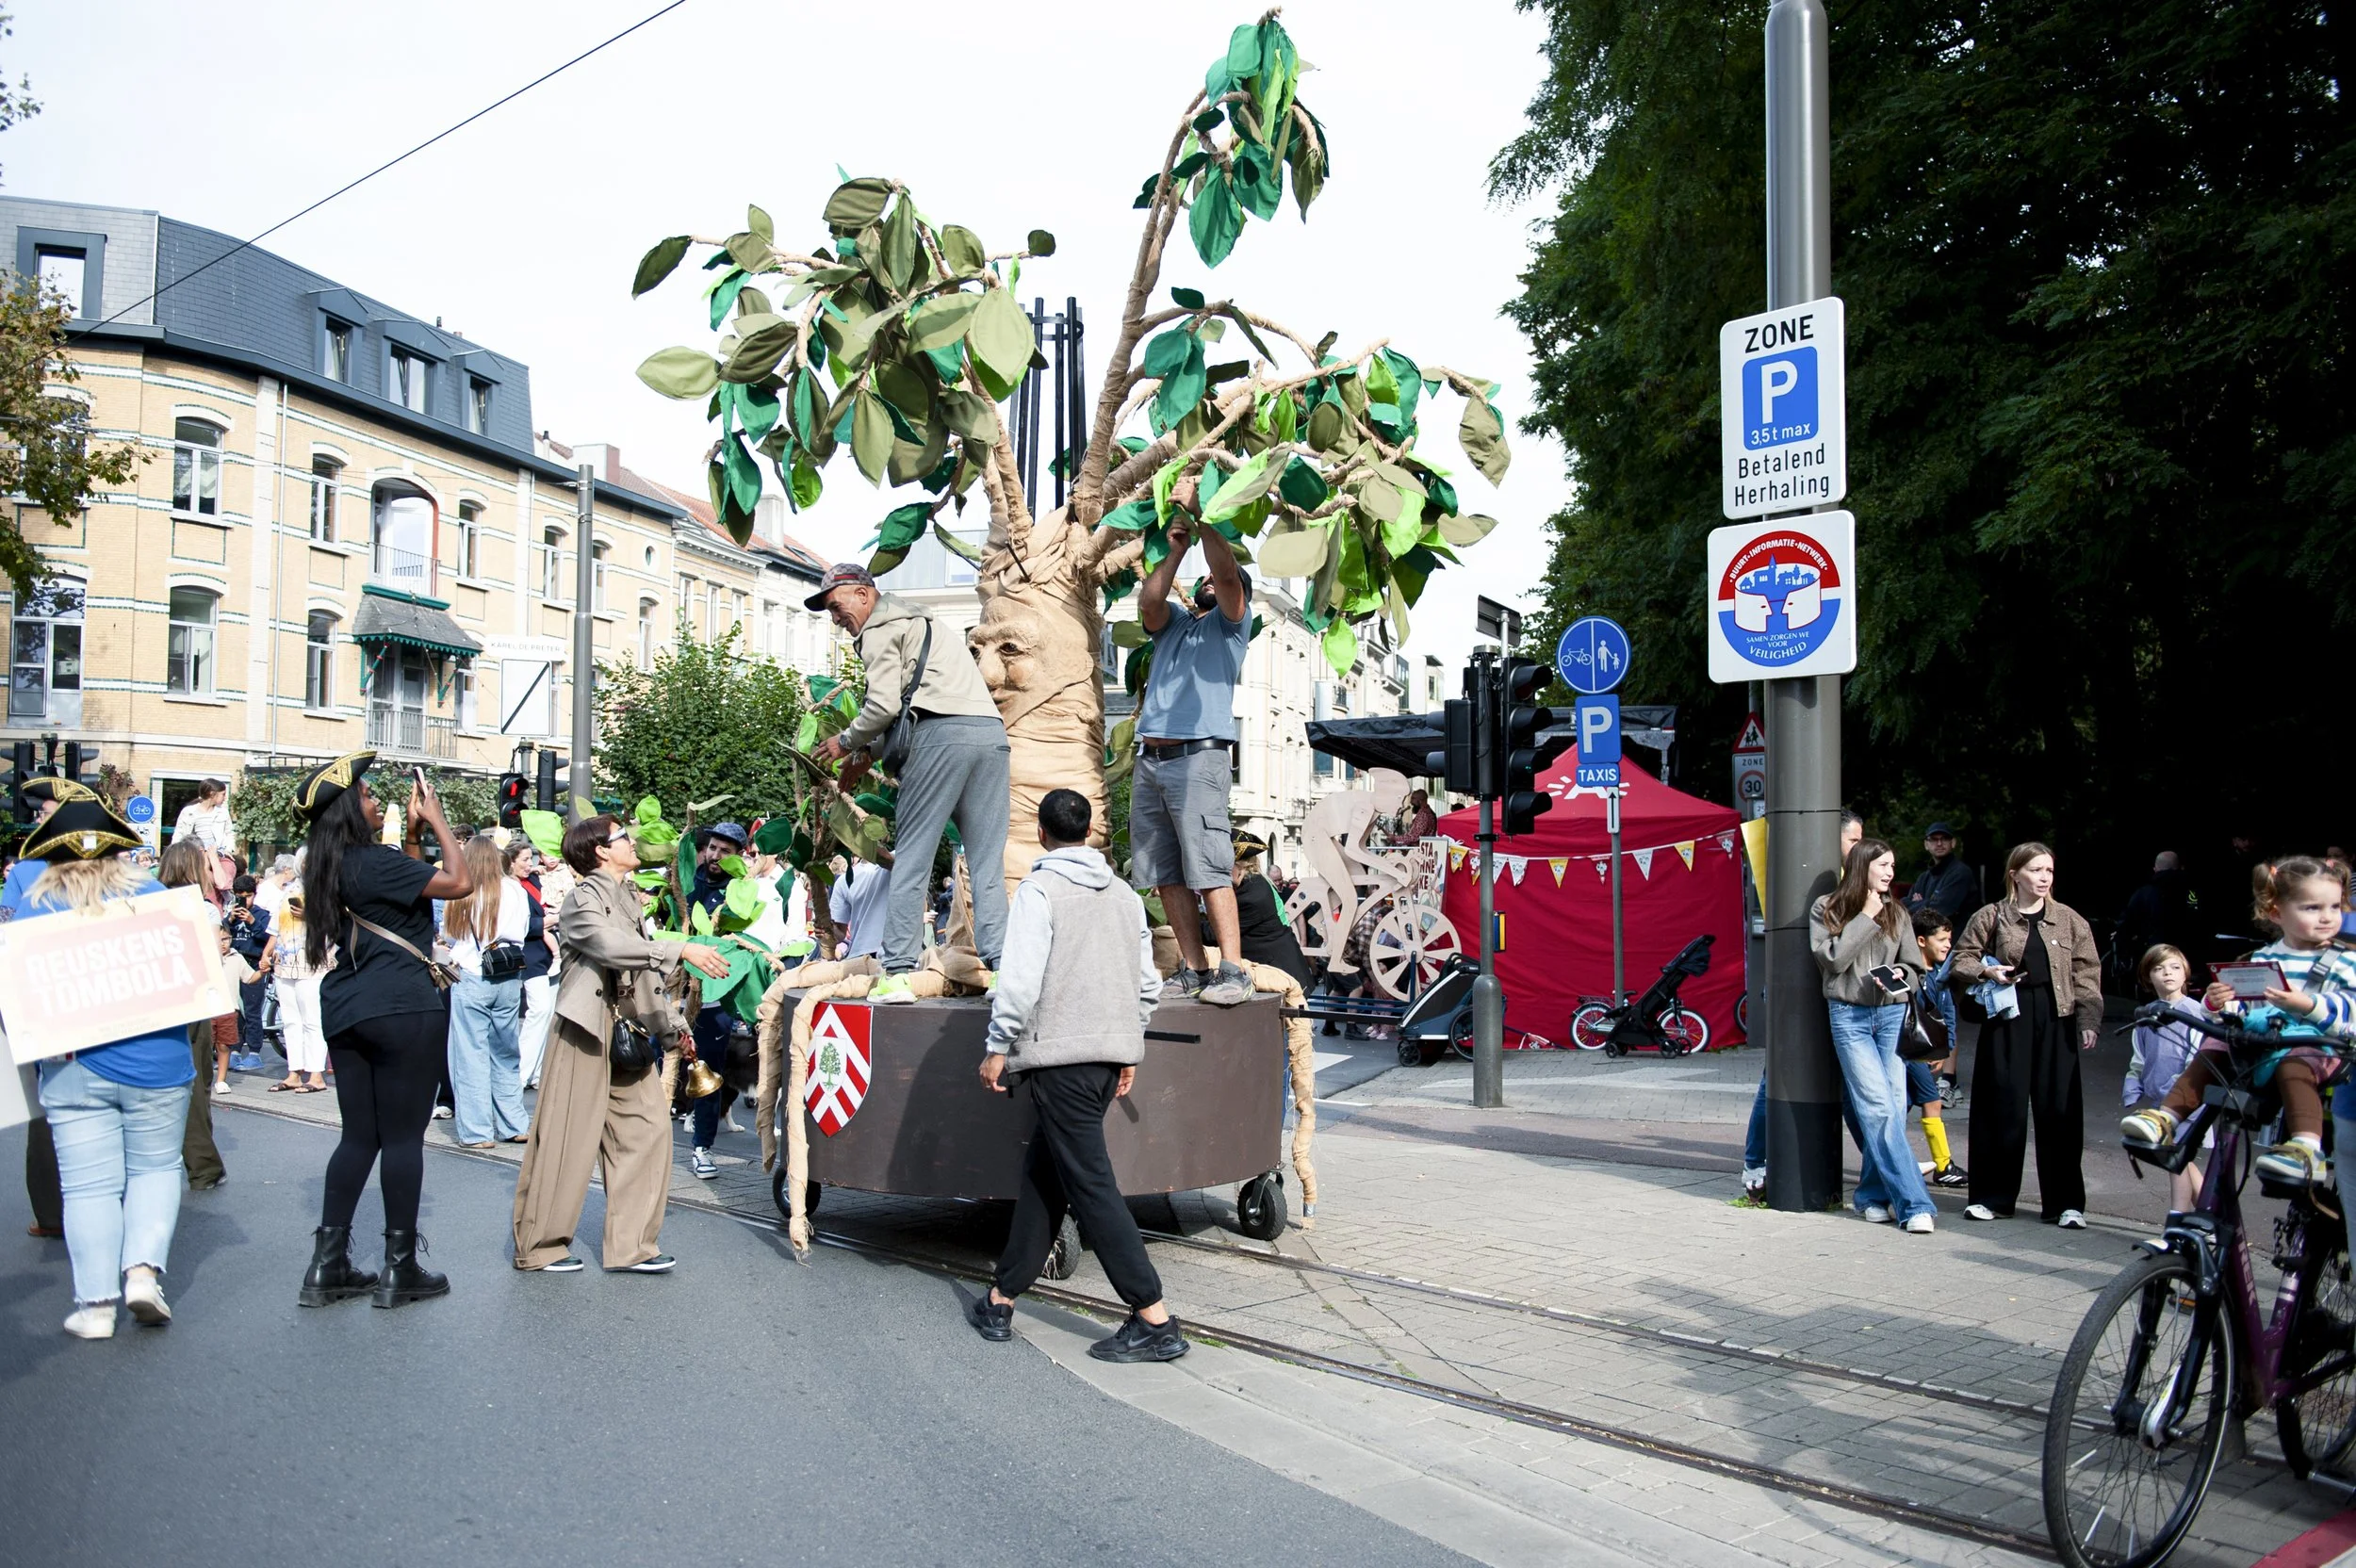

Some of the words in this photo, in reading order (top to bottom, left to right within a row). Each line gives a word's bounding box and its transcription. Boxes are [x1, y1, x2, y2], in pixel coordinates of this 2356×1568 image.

[1744, 314, 1814, 354] ZONE
[1760, 360, 1798, 424] P
[1781, 422, 1810, 440] max
[1739, 444, 1824, 479] Betalend
[1735, 475, 1829, 507] Herhaling
[1746, 635, 1769, 644] SAMEN
[1749, 642, 1808, 660] VEILIGHEID
[1581, 706, 1612, 753] P
[1742, 758, 1764, 766] ZONE
[1578, 768, 1617, 782] TAXIS
[1744, 779, 1761, 792] 30
[1421, 841, 1432, 858] STA
[25, 924, 186, 985] REUSKENS
[31, 955, 195, 1018] TOMBOLA
